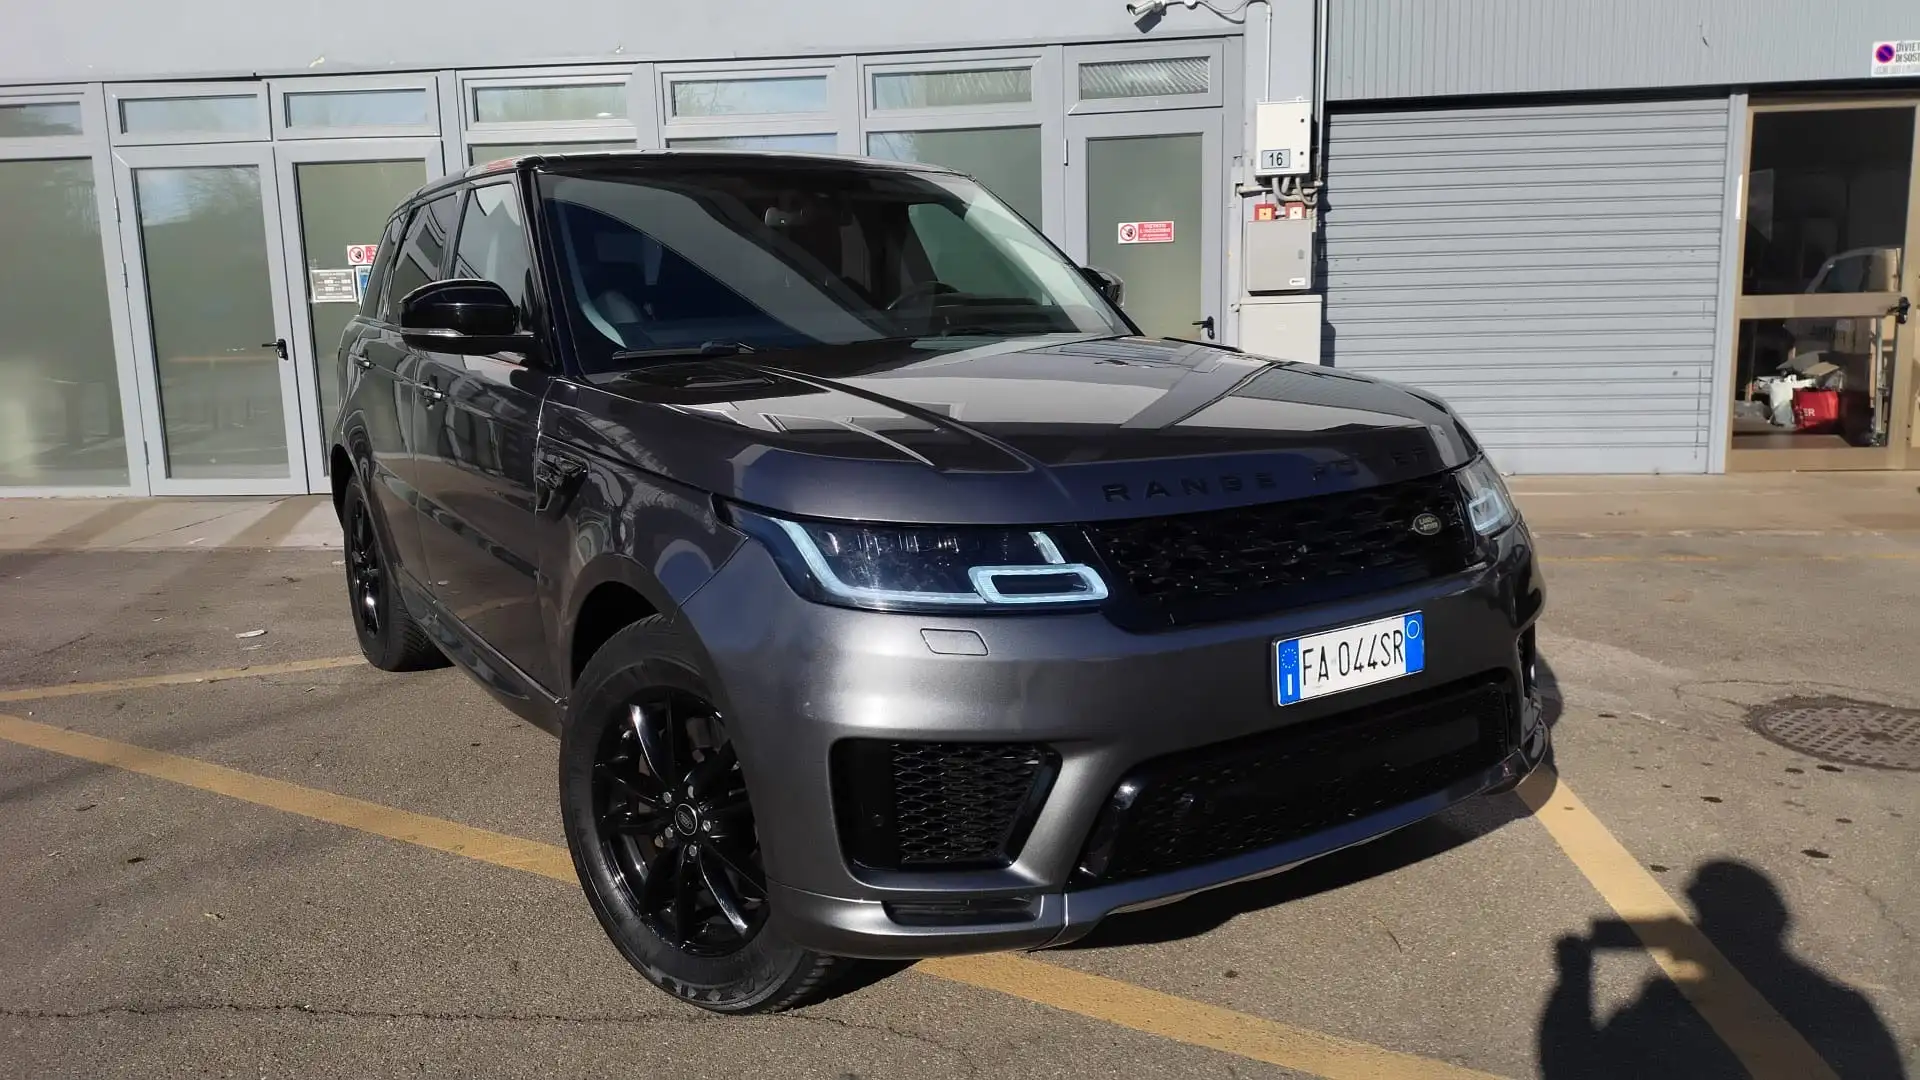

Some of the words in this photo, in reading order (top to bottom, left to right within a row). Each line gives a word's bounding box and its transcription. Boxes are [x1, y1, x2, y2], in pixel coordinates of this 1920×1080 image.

[1268, 152, 1283, 166] 16
[1102, 472, 1277, 502] RANGE
[1311, 445, 1428, 480] ROER
